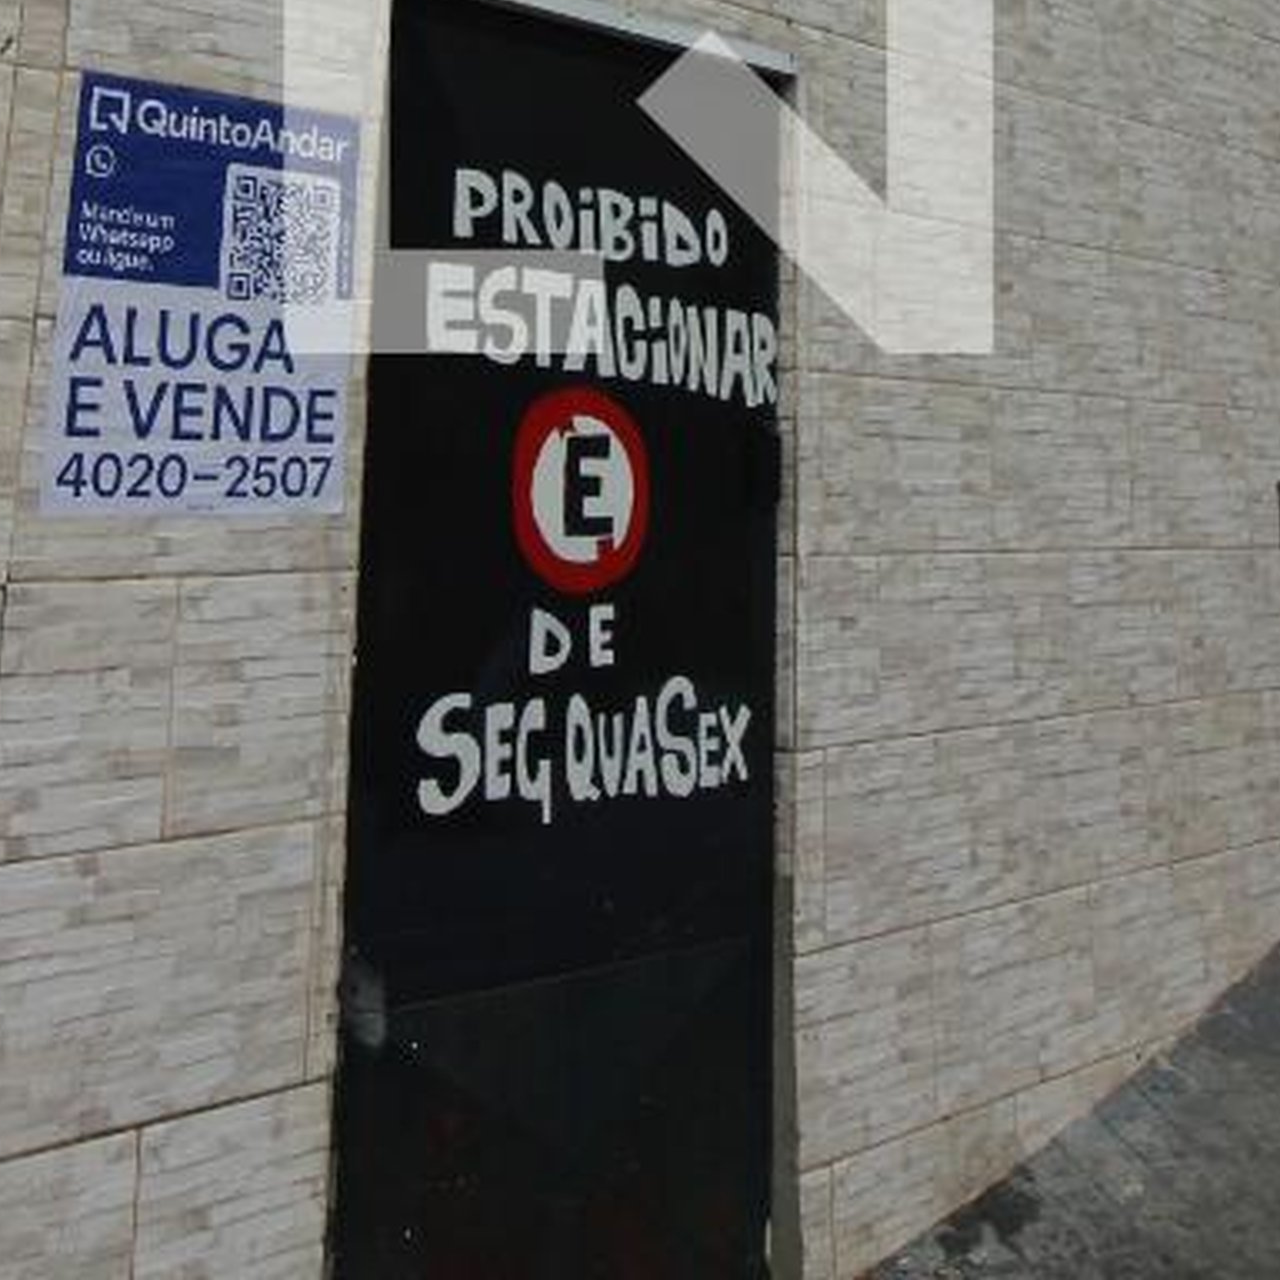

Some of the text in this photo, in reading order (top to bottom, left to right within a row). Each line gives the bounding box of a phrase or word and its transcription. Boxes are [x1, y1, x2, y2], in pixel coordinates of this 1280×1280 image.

[135, 98, 350, 163] QuintoAndar
[69, 304, 294, 374] ALUGA
[65, 376, 336, 444] E VENDE
[56, 452, 332, 499] 4020-2507
[563, 433, 614, 538] E
